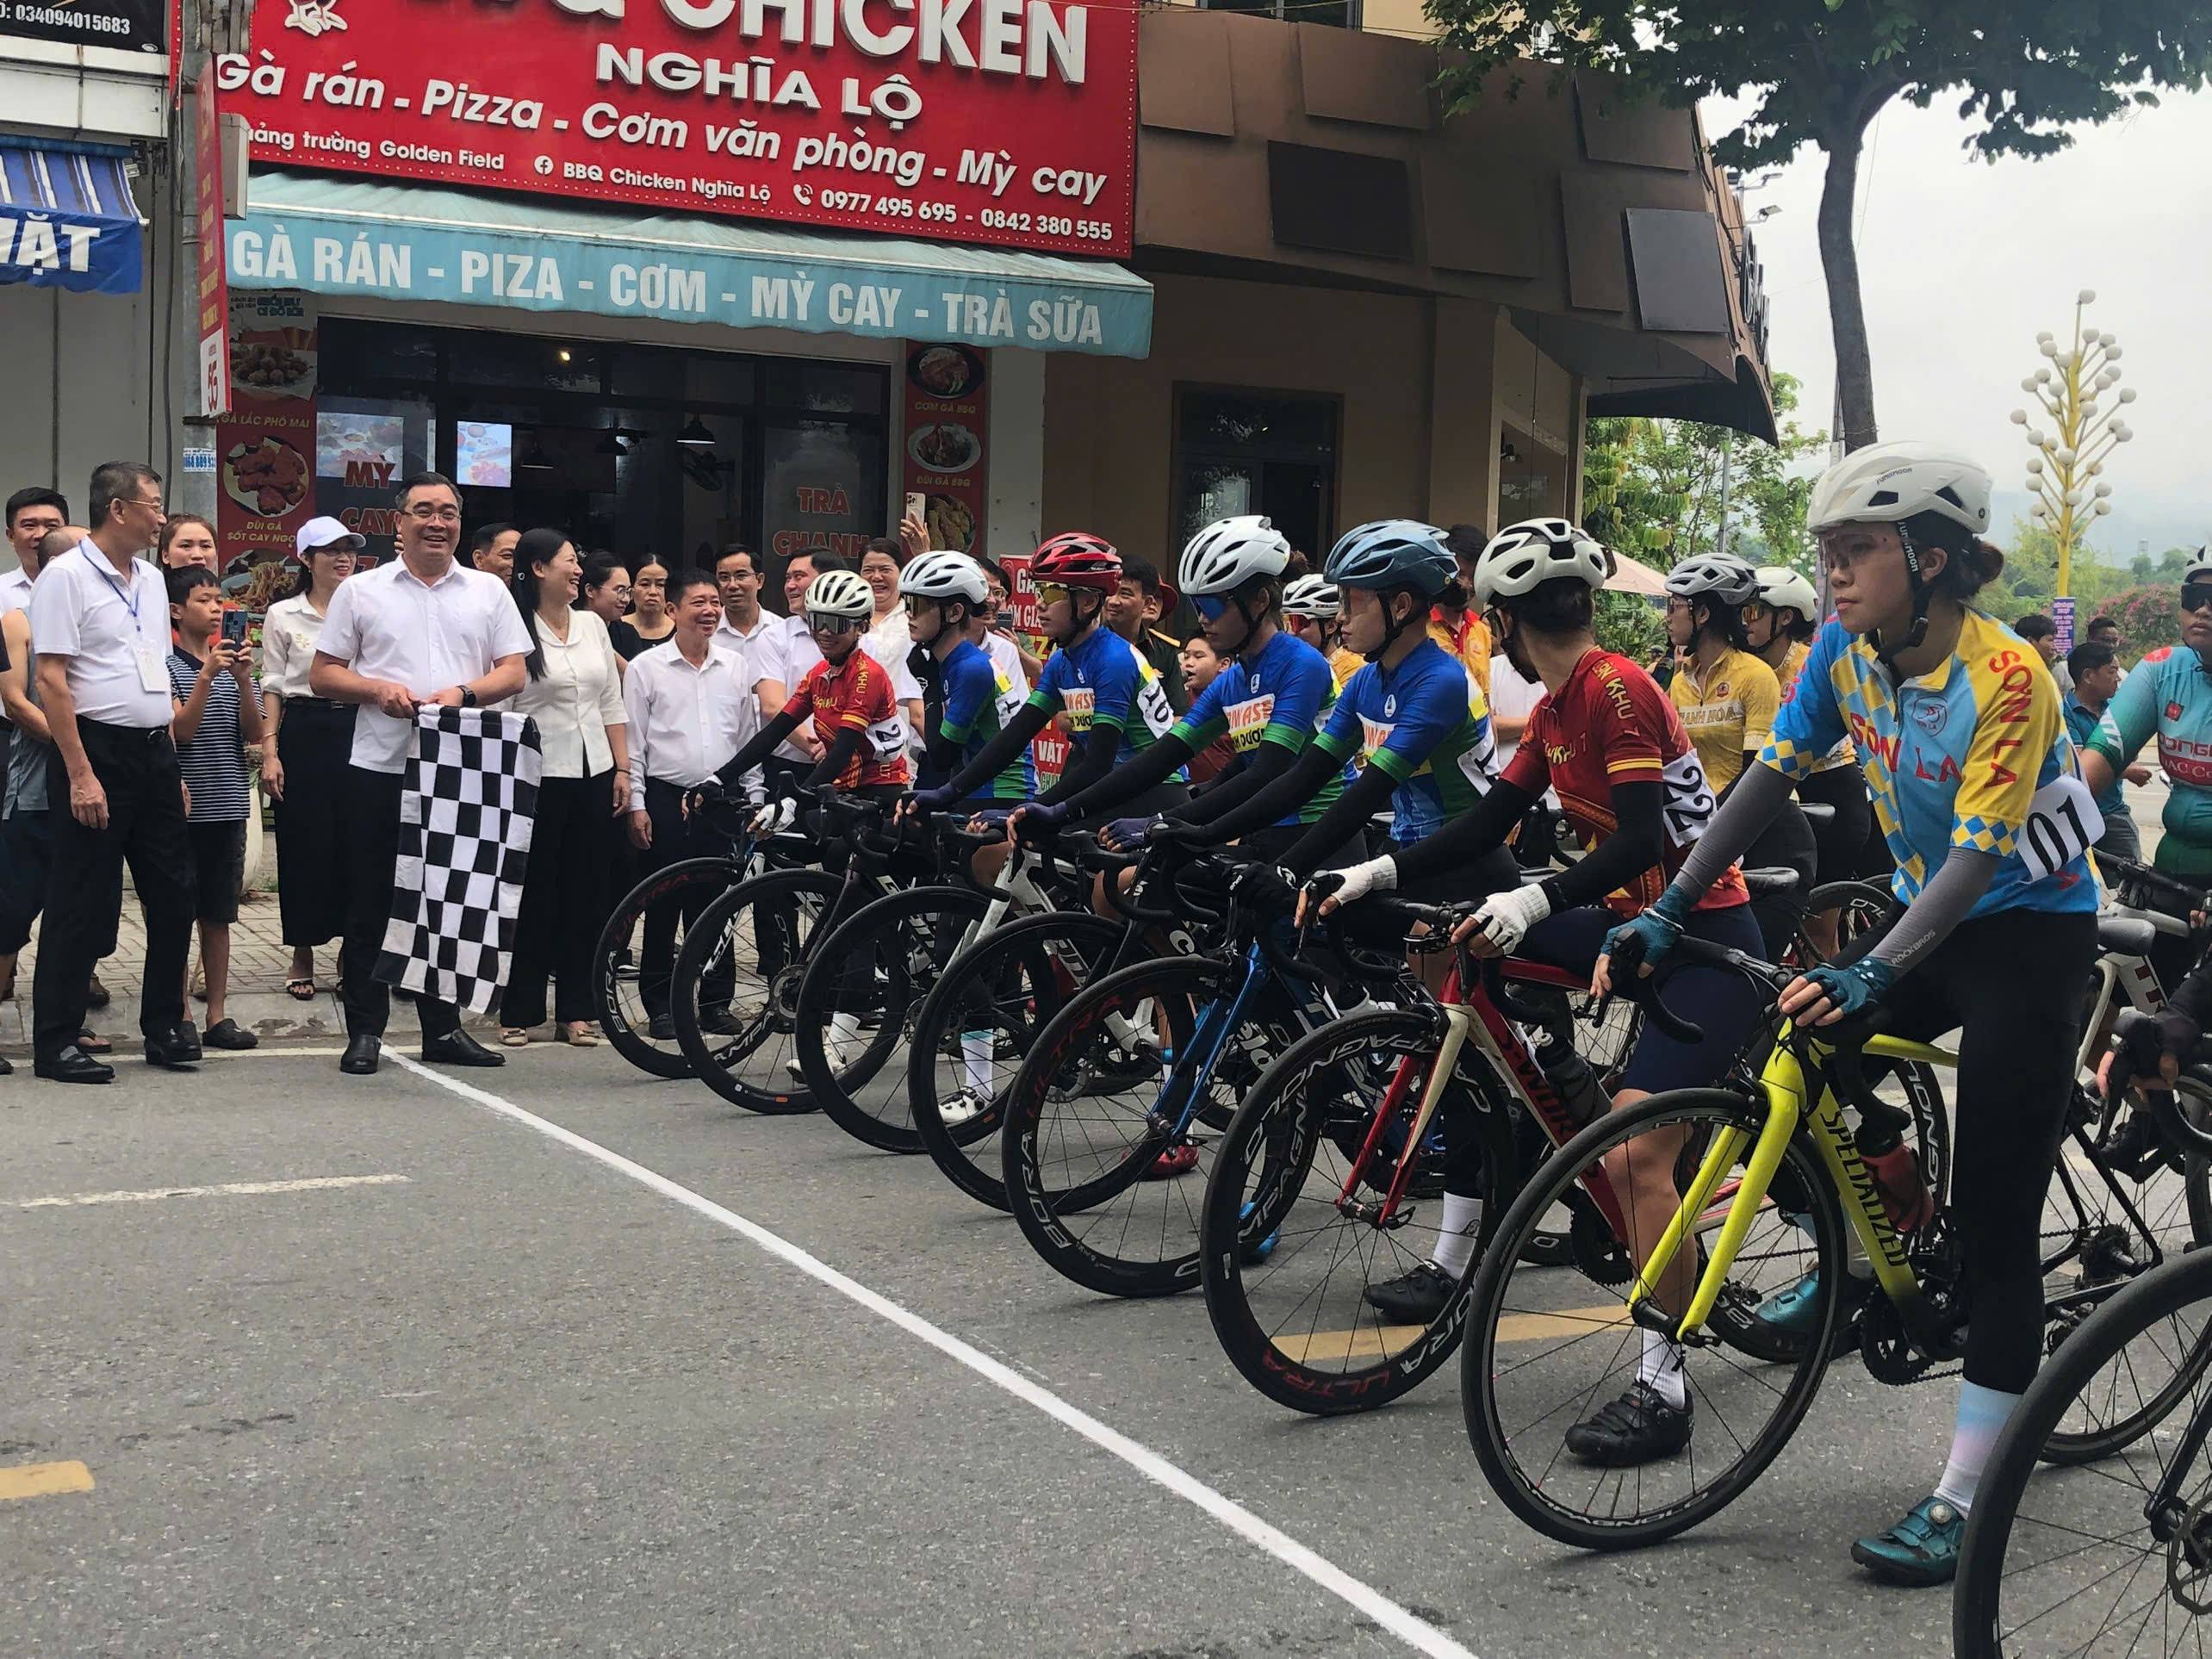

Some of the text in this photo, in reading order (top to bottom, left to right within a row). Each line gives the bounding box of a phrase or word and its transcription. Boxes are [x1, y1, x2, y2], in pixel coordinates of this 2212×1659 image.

[16, 4, 131, 34] 034094015683
[596, 43, 923, 130] NGHĨA LỘ
[217, 49, 285, 96] Gà
[303, 60, 385, 109] rán
[421, 79, 544, 129] Pizza
[582, 103, 688, 149] Cơm
[705, 119, 781, 159] văn
[792, 127, 925, 187] phòng
[957, 149, 1018, 196] Mỳ
[1032, 166, 1107, 206] cay
[248, 122, 295, 151] ảng
[303, 130, 370, 158] trường
[380, 140, 452, 165] Golden
[459, 149, 505, 171] Field
[563, 162, 604, 182] BBQ
[610, 167, 687, 191] Chicken
[692, 177, 745, 199] Nghĩa
[750, 184, 771, 205] Lộ
[821, 189, 872, 213] 0977
[875, 196, 913, 219] 495
[918, 201, 957, 223] 695
[981, 208, 1031, 232] 0842
[1035, 215, 1072, 237] 380
[1077, 221, 1113, 241] 555
[233, 224, 297, 280] GÀ
[314, 232, 412, 289] RÁN
[461, 251, 564, 301] PIZA
[610, 263, 706, 313] CƠM
[751, 271, 817, 322] MỲ
[828, 283, 902, 328] CAY
[942, 289, 1014, 339] TRÀ
[1028, 296, 1103, 345] SỮA
[289, 418, 310, 429] MAI
[249, 532, 270, 543] CAY
[272, 535, 297, 549] NGỌ
[1605, 677, 1637, 719] KHU
[1038, 738, 1065, 767] VẶT
[1915, 746, 1963, 783] LA
[1984, 739, 2023, 788] LA
[1662, 765, 1714, 834] 22
[2026, 794, 2091, 876] 01
[1820, 1111, 1909, 1267] SPECIALIZED
